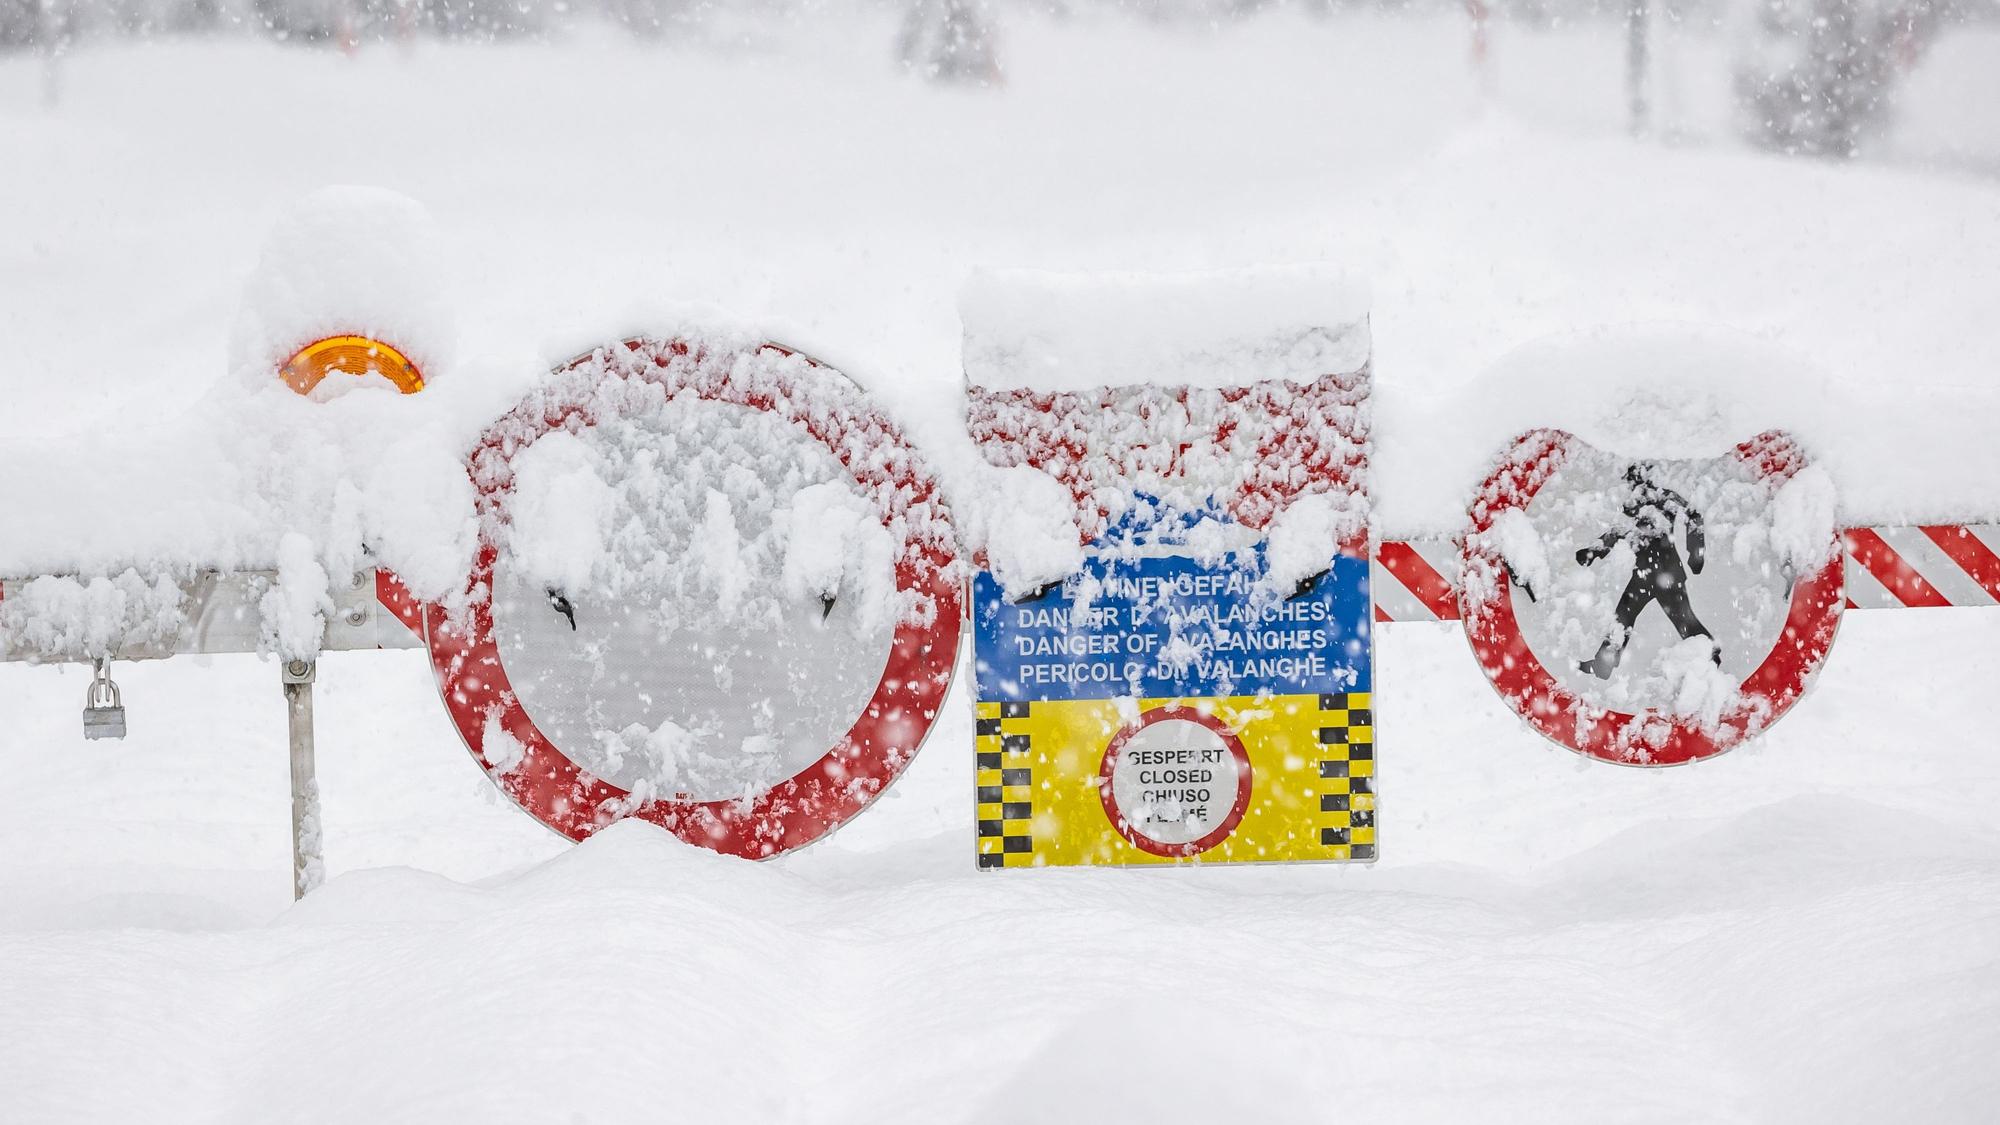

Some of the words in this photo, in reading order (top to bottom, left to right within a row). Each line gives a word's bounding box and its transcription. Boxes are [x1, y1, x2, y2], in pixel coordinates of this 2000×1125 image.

[1019, 607, 1119, 628] DANR
[1019, 634, 1120, 656] DANGER
[1126, 633, 1158, 654] OF
[1020, 662, 1142, 684] PERICOLO
[1196, 657, 1326, 680] VALANGHE
[1140, 769, 1212, 784] CLOSED
[1142, 788, 1211, 803] CHIUSO
